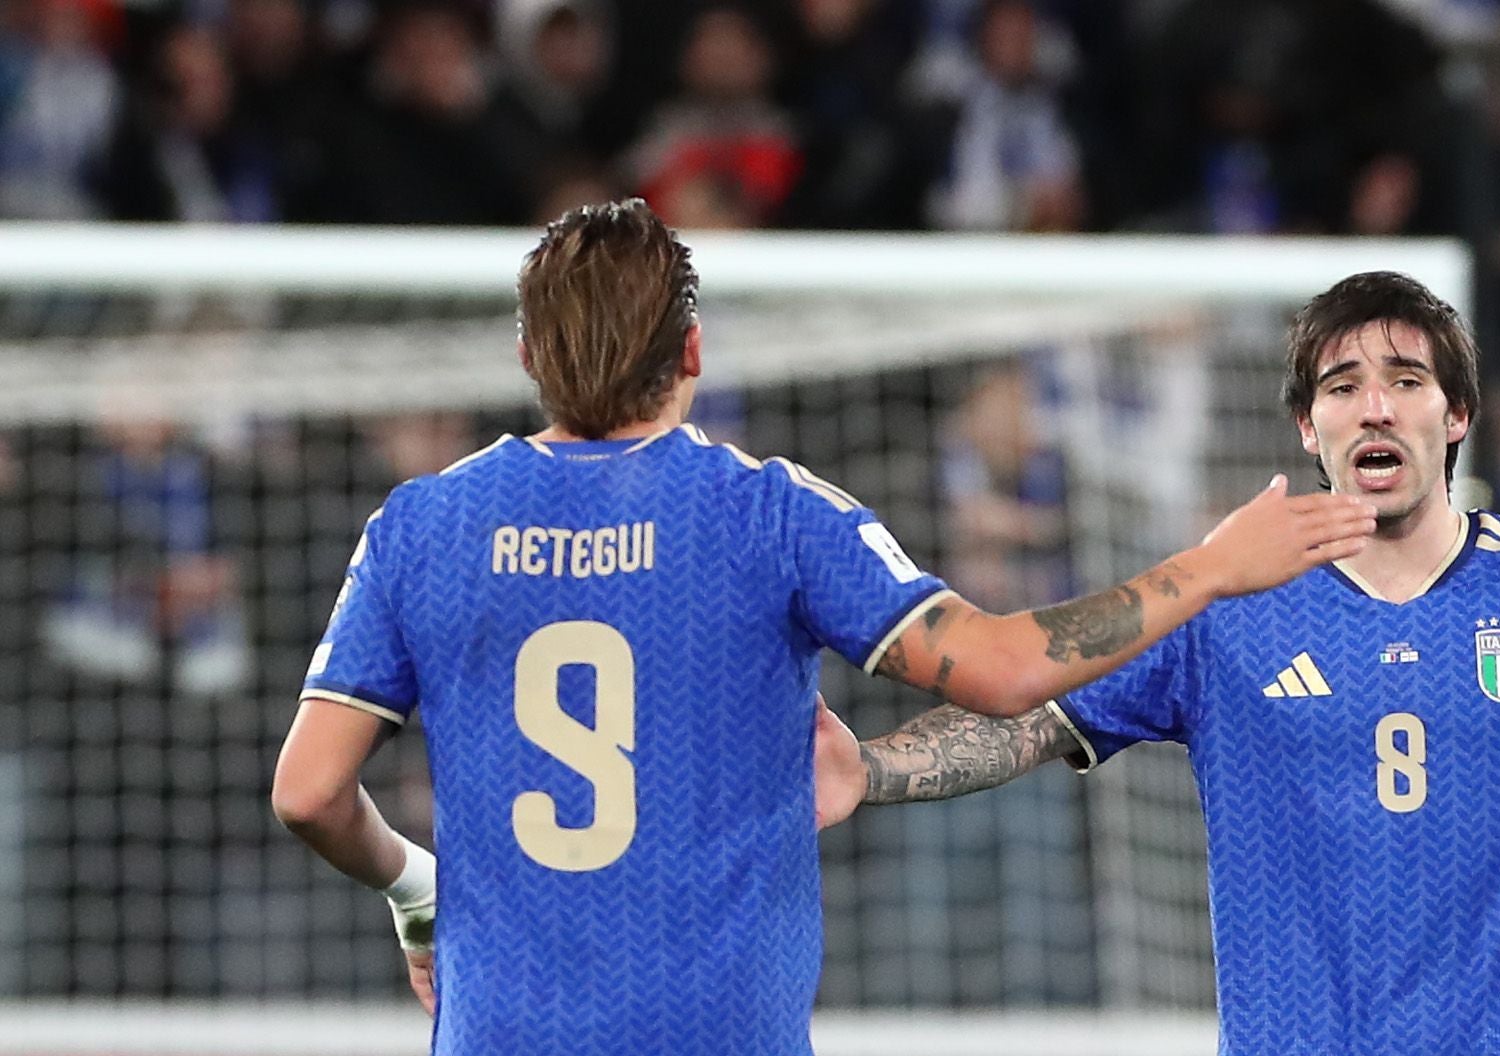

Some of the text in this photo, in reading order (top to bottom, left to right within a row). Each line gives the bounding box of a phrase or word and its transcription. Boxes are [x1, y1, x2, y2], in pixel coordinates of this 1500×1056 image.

[492, 522, 654, 577] RETEGUI
[512, 620, 635, 871] 9
[1375, 713, 1427, 812] 8
